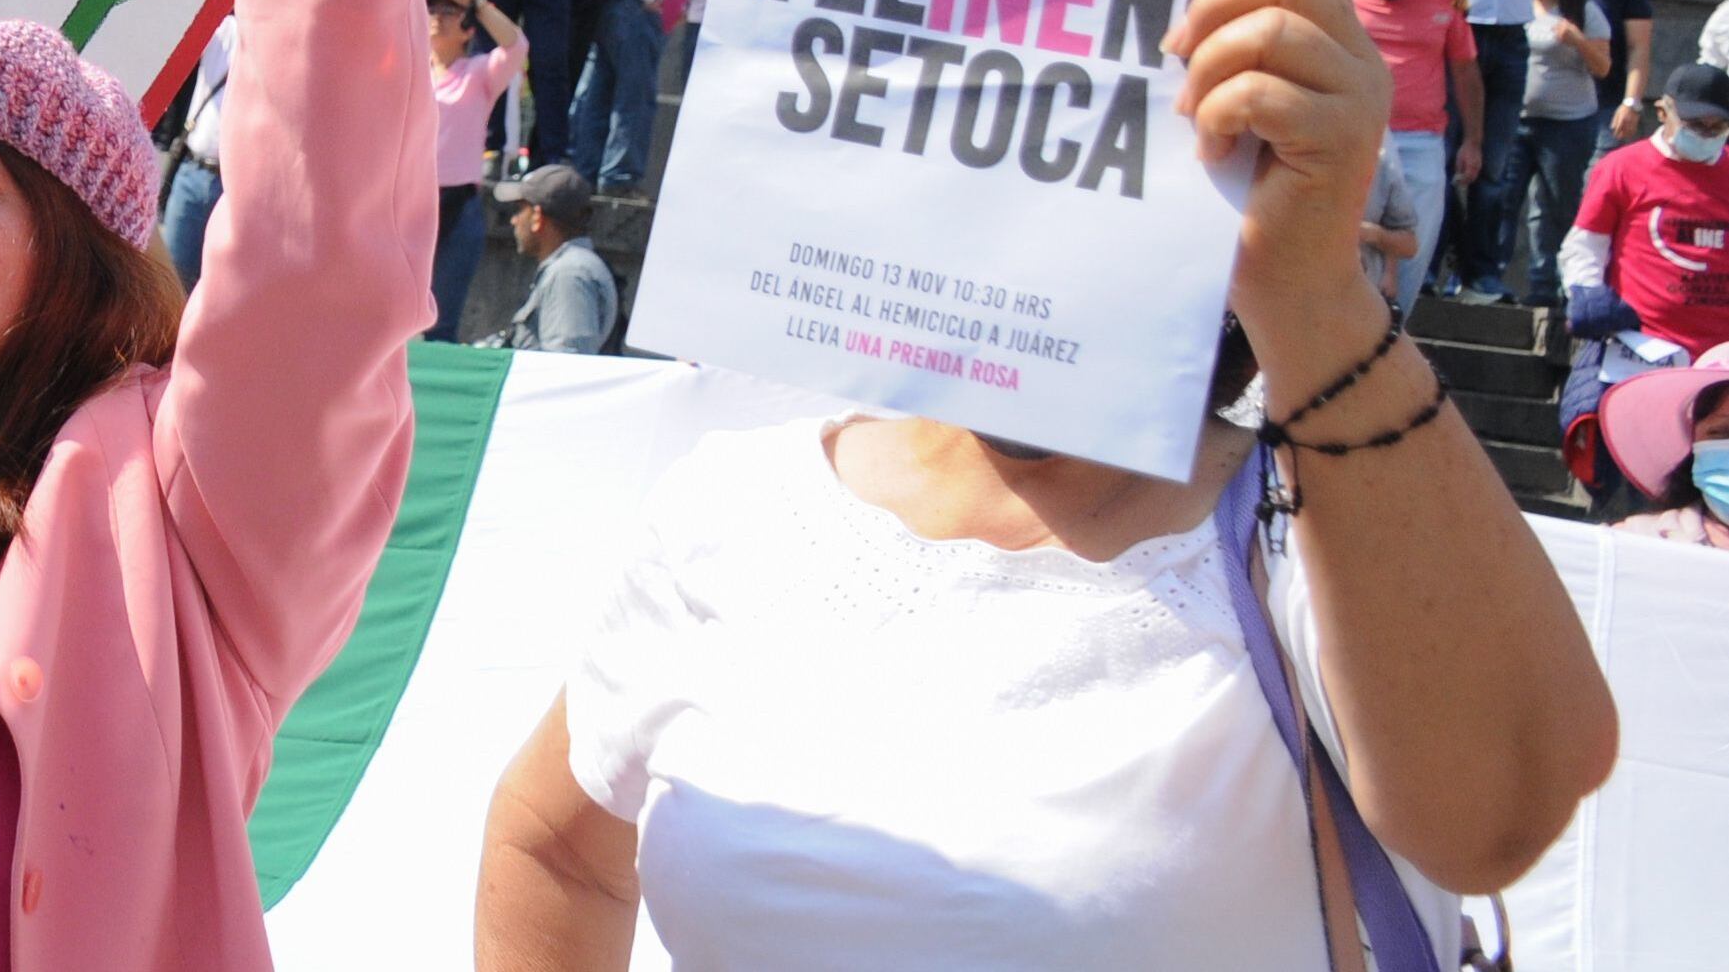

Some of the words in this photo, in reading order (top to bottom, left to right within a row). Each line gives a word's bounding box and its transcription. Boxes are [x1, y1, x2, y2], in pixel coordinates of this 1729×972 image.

[775, 17, 1149, 200] SETOCA
[750, 270, 781, 297] DEL
[788, 275, 844, 311] ÁNGEL
[850, 293, 872, 318] AL
[879, 299, 982, 343] HEMICICLO
[987, 324, 1000, 346] A
[1005, 327, 1080, 365] JUÁREZ
[789, 242, 873, 279] DOMINGO
[882, 263, 902, 286] 13
[907, 268, 947, 295] NOV
[953, 279, 1007, 310] 10:30
[1012, 292, 1052, 320] HRS
[786, 315, 840, 347] LLEVA
[845, 329, 882, 358] UNA
[888, 339, 963, 378] PRENDA
[970, 358, 1020, 390] ROSA
